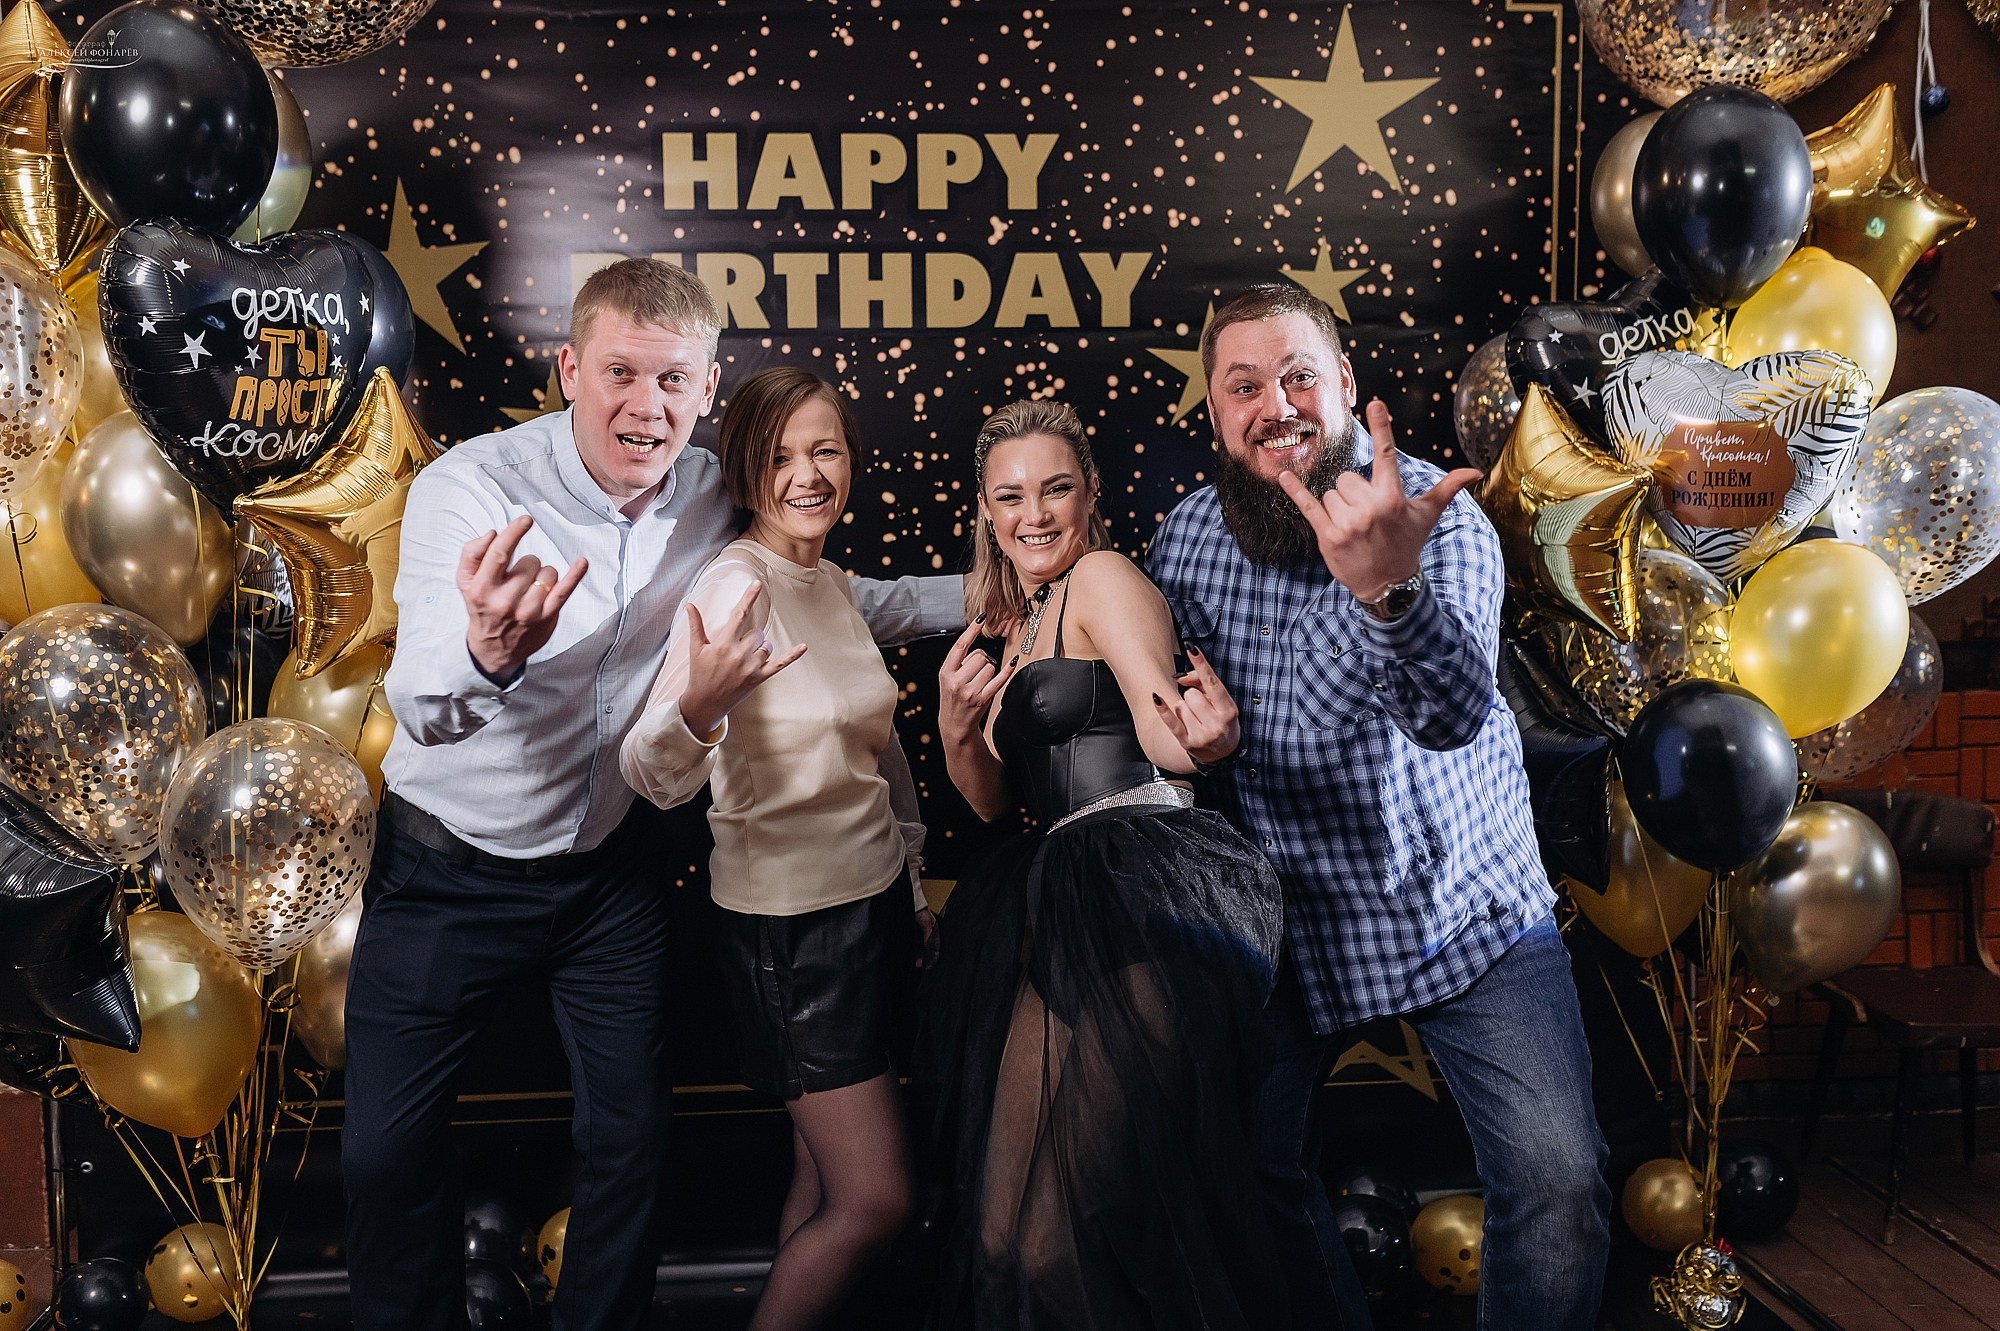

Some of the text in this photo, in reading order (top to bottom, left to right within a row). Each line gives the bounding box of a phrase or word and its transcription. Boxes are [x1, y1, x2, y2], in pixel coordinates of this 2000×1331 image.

[661, 132, 1061, 211] HAPPY
[570, 252, 1153, 329] RTHDAY
[260, 327, 329, 378] ТЫ
[1683, 427, 1745, 451] Привет,
[1700, 444, 1771, 468] Красотка!
[1687, 468, 1752, 490] С ДНЁМ
[1671, 489, 1775, 510] РОЖДЕНИЯ!
